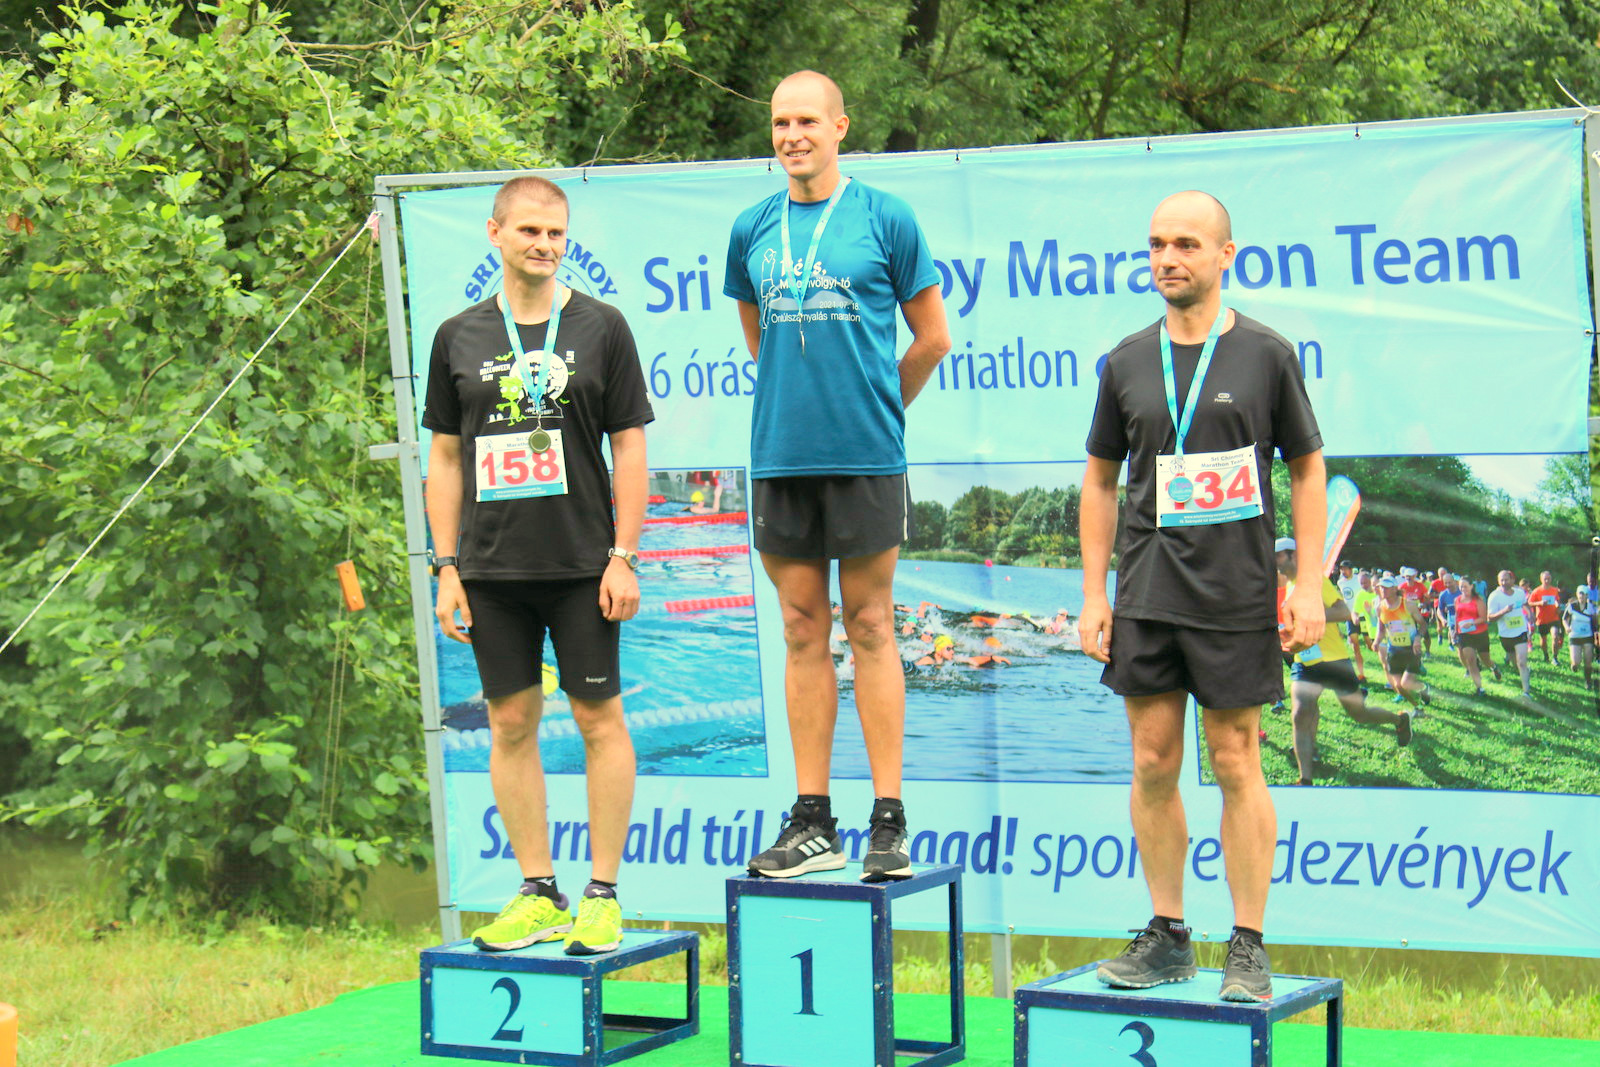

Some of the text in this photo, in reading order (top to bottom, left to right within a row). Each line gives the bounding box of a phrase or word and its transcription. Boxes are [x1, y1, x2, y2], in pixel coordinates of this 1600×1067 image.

[465, 252, 501, 302] SRI
[644, 254, 711, 313] Sri
[1008, 239, 1317, 298] Maraon
[1335, 224, 1520, 285] Team
[830, 312, 861, 322] maraton
[650, 352, 671, 399] 6
[684, 347, 757, 398] órás
[481, 448, 560, 486] 158
[480, 805, 691, 865] Srnald
[702, 809, 764, 866] túl
[790, 947, 824, 1017] 1
[490, 976, 525, 1042] 2
[1118, 1020, 1157, 1067] 3
